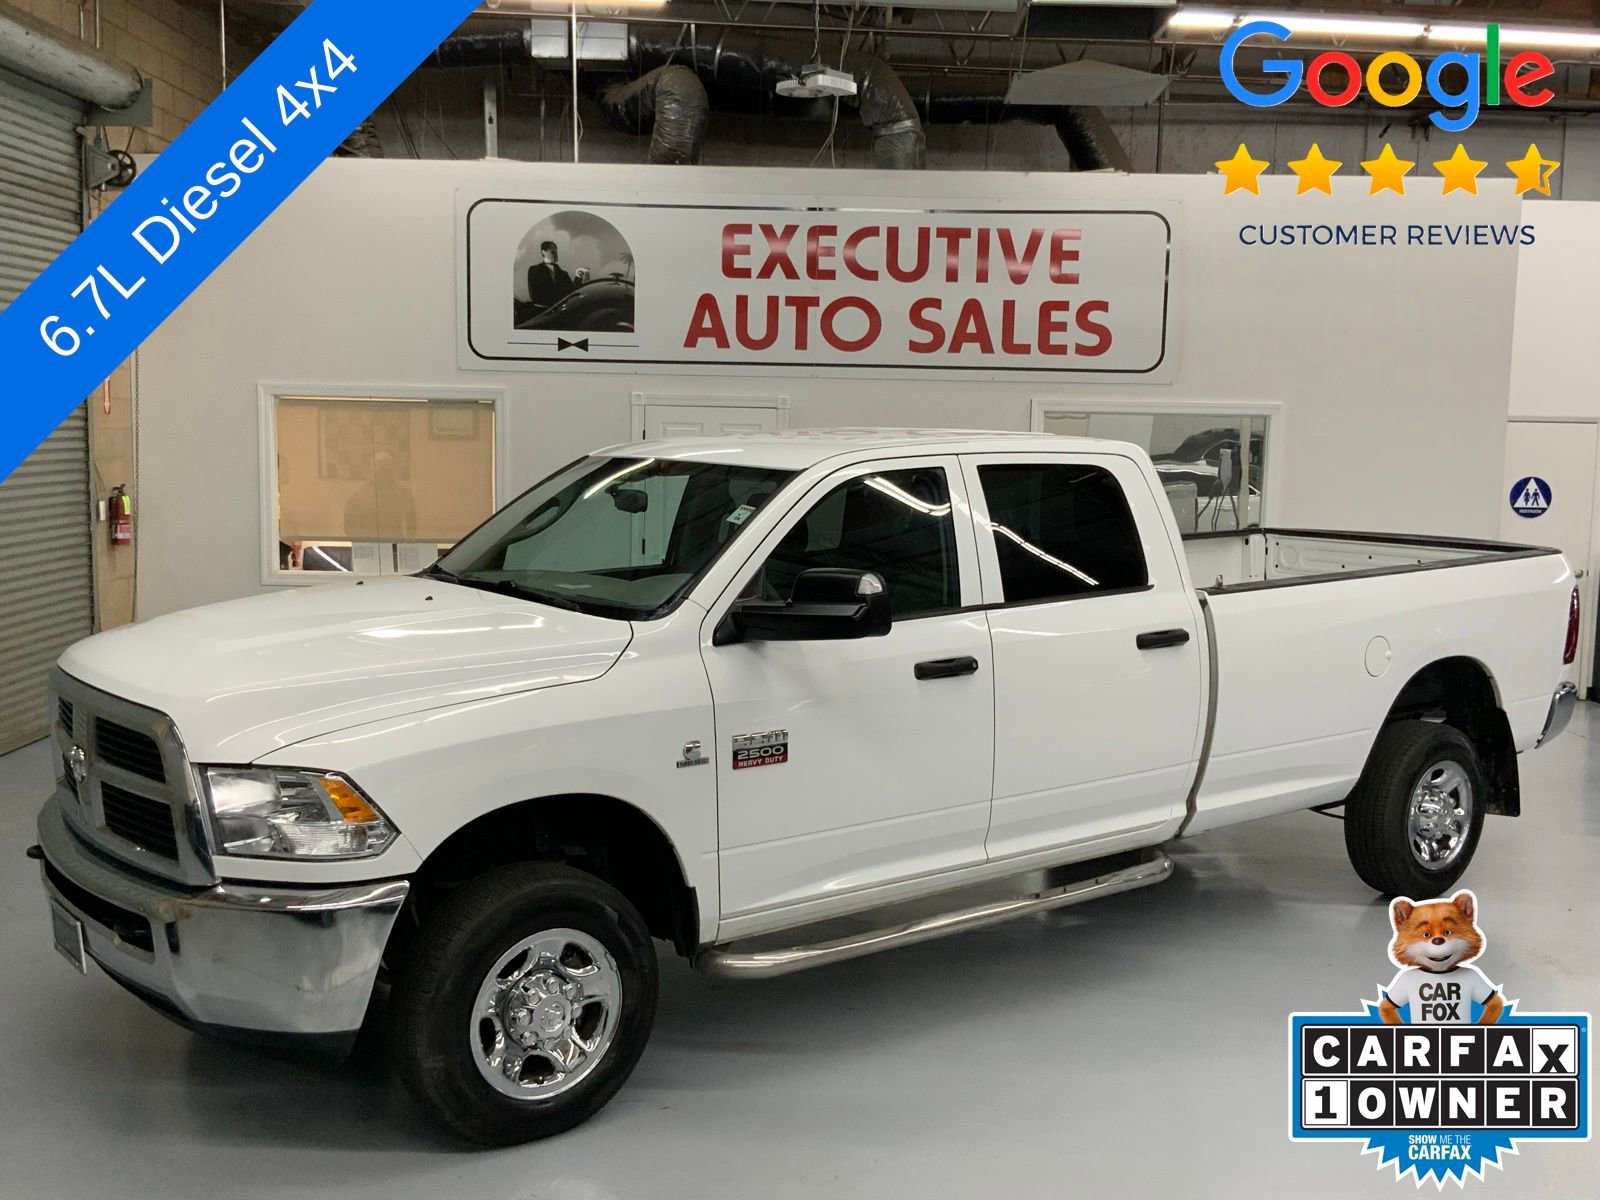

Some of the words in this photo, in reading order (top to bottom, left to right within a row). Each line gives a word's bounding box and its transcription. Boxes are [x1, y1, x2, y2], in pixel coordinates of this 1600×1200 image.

[721, 222, 1082, 285] EXECUTIVE
[683, 293, 882, 353] AUTO
[908, 297, 1113, 357] SALES
[737, 745, 785, 760] 2500
[738, 758, 763, 768] HEAVY
[764, 755, 784, 764] DUTY
